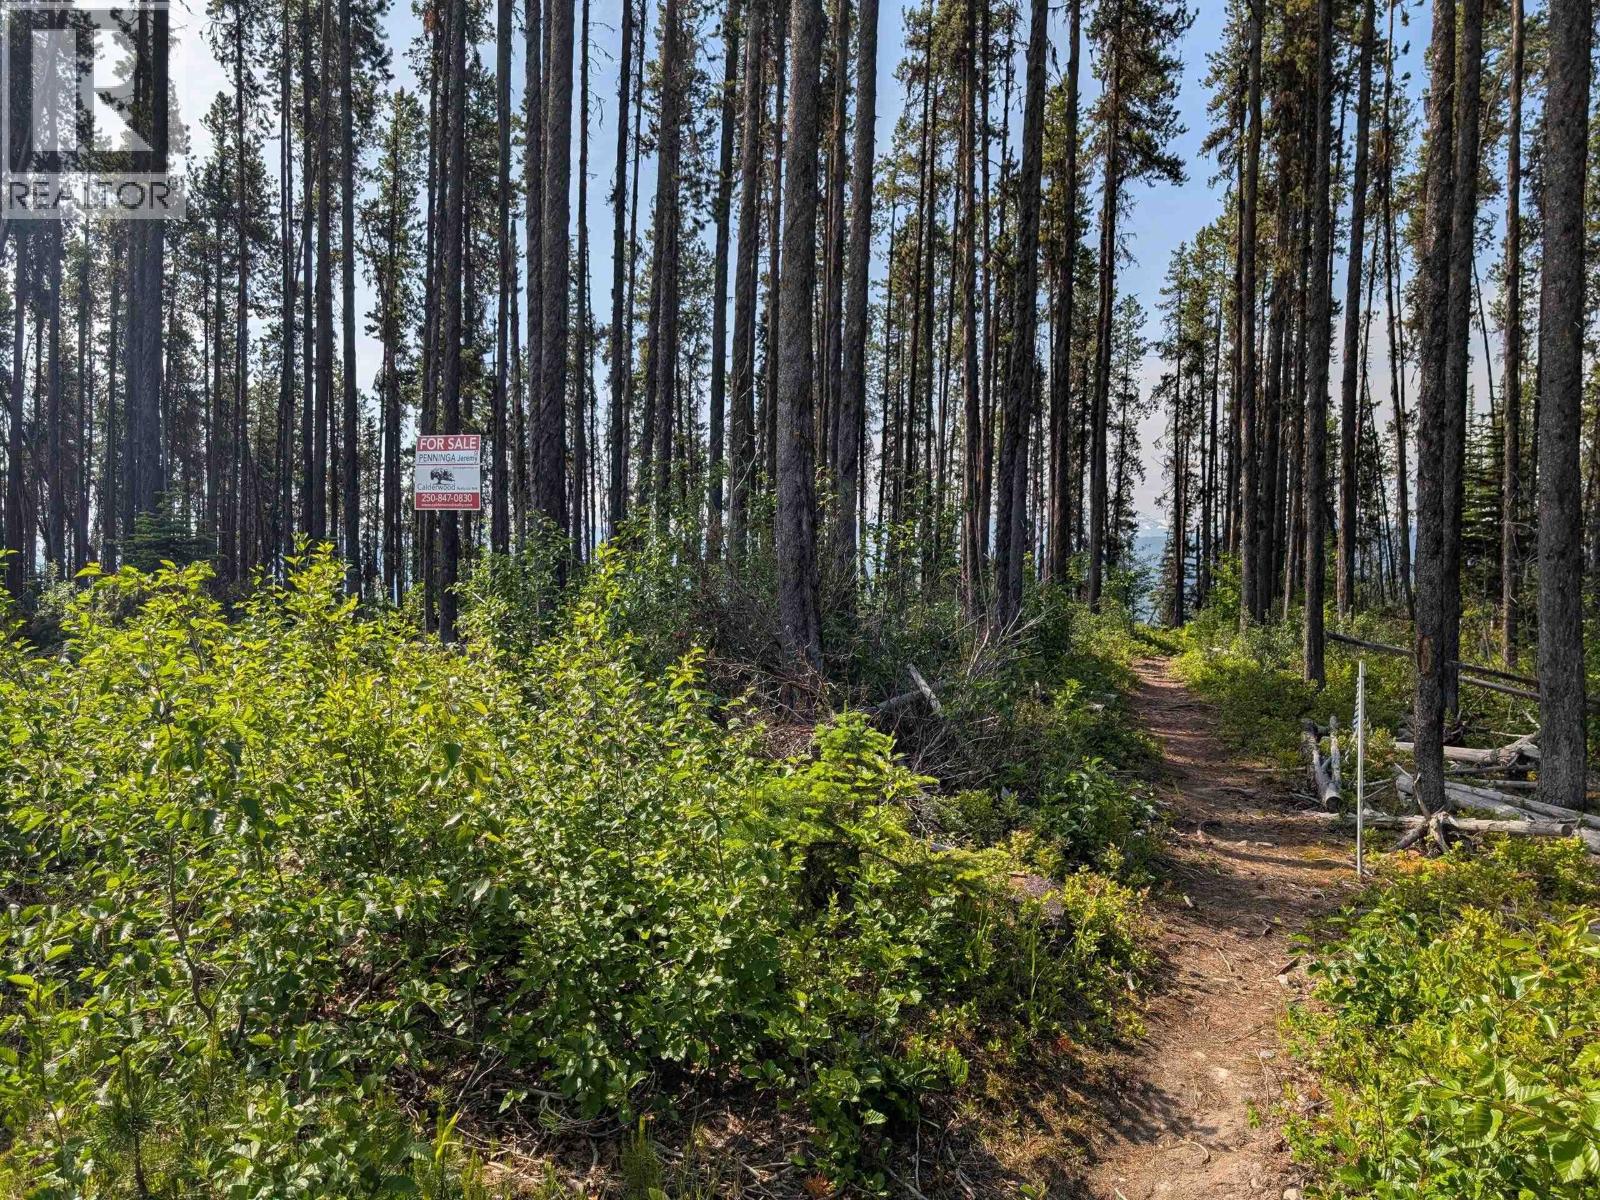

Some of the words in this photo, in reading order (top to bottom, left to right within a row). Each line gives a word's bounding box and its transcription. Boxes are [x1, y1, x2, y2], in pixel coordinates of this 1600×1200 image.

[420, 438, 445, 450] FOR
[447, 437, 477, 450] SALE
[419, 453, 456, 462] PENNINGA
[457, 454, 478, 464] Jeremy
[417, 482, 456, 490] Calderwood
[421, 493, 473, 503] 250-847-0830
